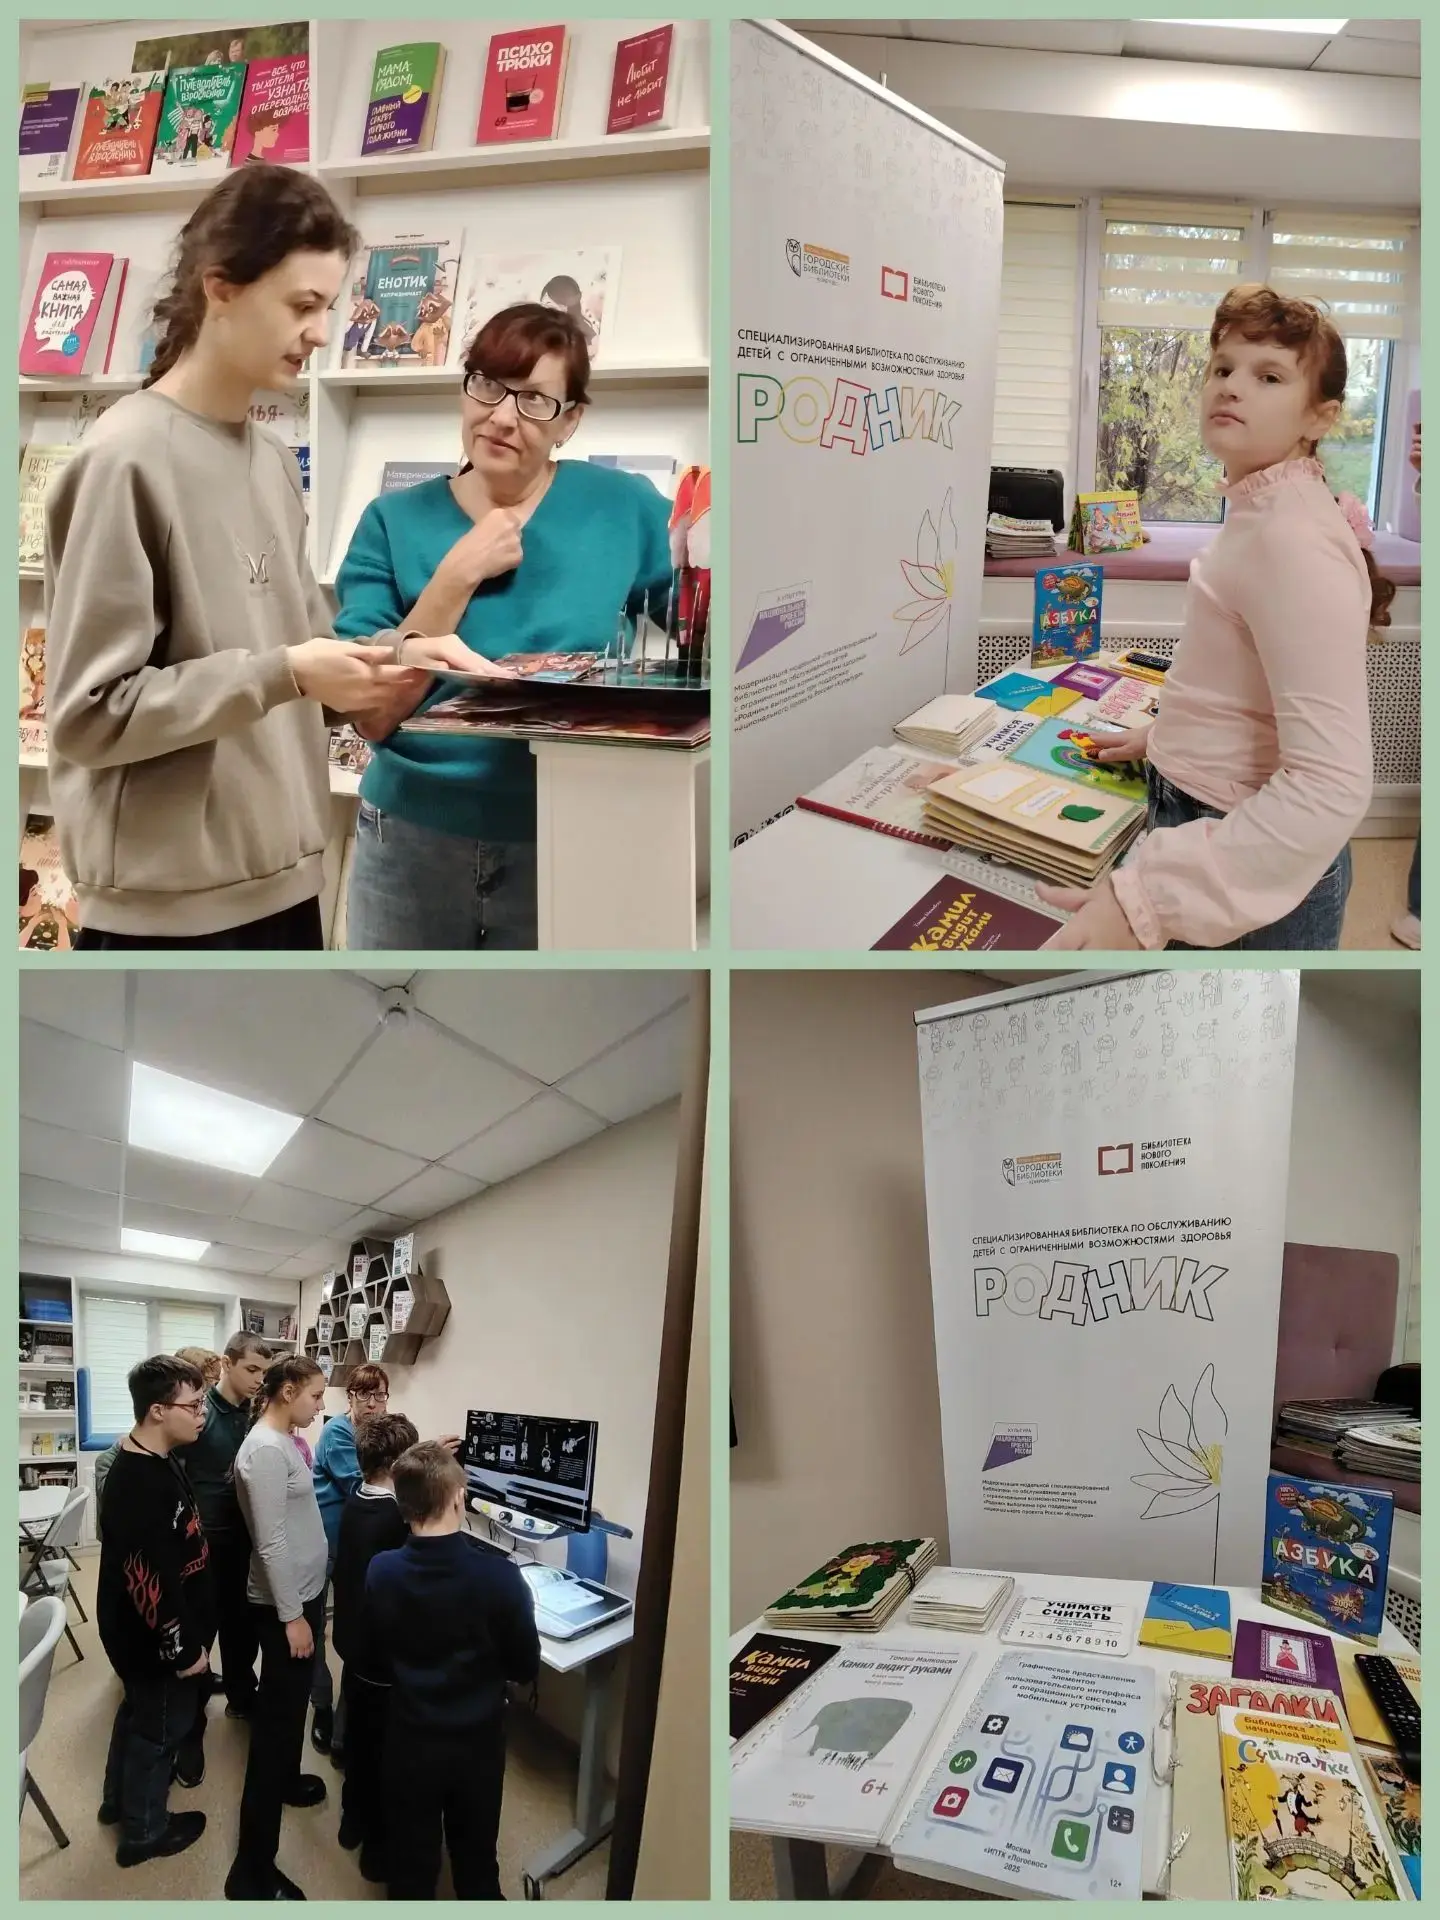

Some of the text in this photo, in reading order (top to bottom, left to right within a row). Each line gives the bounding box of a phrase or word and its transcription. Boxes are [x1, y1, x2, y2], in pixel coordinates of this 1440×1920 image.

[498, 41, 553, 60] ПСИХО
[290, 60, 306, 72] ЧТО
[496, 53, 551, 72] ТРЮКИ
[251, 72, 295, 92] ТЫ ХОТЕЛА
[268, 79, 310, 100] УЗНАТЬ
[375, 74, 413, 92] РЯДОМ!
[257, 92, 310, 113] ПЕРЕХОДНО
[803, 253, 851, 274] ГОРОДСКИЕ
[803, 263, 850, 283] БИБЛИОТЕКИ
[51, 280, 87, 292] САМАЯ
[377, 275, 428, 289] ЕНОТИК
[52, 293, 81, 302] ВАЖНАЯ
[41, 301, 84, 320] КНИГА
[737, 329, 966, 369] СПЕЦИАЛИЗИРОВАННАЯ БИБЛИОТЕКА ПО ОБСЛУЖИВАНИЮ
[737, 346, 965, 381] ДЕТЕЙ С ОГРАНИЧЕННЫМИ ВОЗМОЖНОСТЯМИ ЗДОРОВЬЯ
[737, 373, 962, 456] РОДНИК
[1042, 608, 1097, 628] АЗБУКА
[982, 719, 1022, 748] УЧИМСЯ
[995, 721, 1035, 752] СЧИТАТЬ
[942, 909, 978, 948] видит
[956, 911, 993, 950] уками
[1141, 1137, 1192, 1151] БИБЛИОТЕКА
[1141, 1149, 1172, 1160] НОВОГО
[1141, 1158, 1186, 1170] ПОКОЛЕНИЯ
[1016, 1160, 1063, 1173] ГОРОДСКИЕ
[1016, 1168, 1063, 1180] БИБЛИОТЕКИ
[972, 1216, 1232, 1245] СПЕЦИАЛИЗИРОВАННАЯ БИБЛИОТЕКА ПО ОБСЛУЖИВАНИЮ
[972, 1231, 1232, 1259] ДЕТЕЙ С ОГРАНИЧЕННЫМИ ВОЗМОЖНОСТЯМИ ЗДОРОВЬЯ
[974, 1256, 1229, 1327] РОДНИК
[1275, 1540, 1375, 1584] АЗБУКА
[1042, 1609, 1111, 1621] СЧИТАТЬ
[1046, 1601, 1112, 1612] УЧИМСЯ
[1046, 1632, 1053, 1640] 4
[1065, 1634, 1072, 1642] 6
[1085, 1636, 1091, 1644] 8
[1105, 1639, 1118, 1648] 10
[740, 1650, 811, 1669] Камил
[838, 1659, 953, 1675] Камил видит руками
[730, 1671, 780, 1685] руками
[745, 1664, 787, 1677] видит
[1018, 1661, 1136, 1685] Графическое представление
[1051, 1673, 1096, 1686] элементов
[1004, 1675, 1141, 1701] пользовательского интерфейса
[1018, 1685, 1084, 1701] операционных
[1085, 1695, 1128, 1708] системах
[1016, 1692, 1117, 1715] мобильных устройств
[1244, 1716, 1306, 1733] Библиотека
[1245, 1725, 1338, 1746] начальной школы
[1238, 1739, 1350, 1776] Считалки
[860, 1779, 889, 1796] 6+
[1005, 1842, 1031, 1855] Москва
[1003, 1862, 1021, 1874] 2025
[1109, 1879, 1122, 1888] 12+
